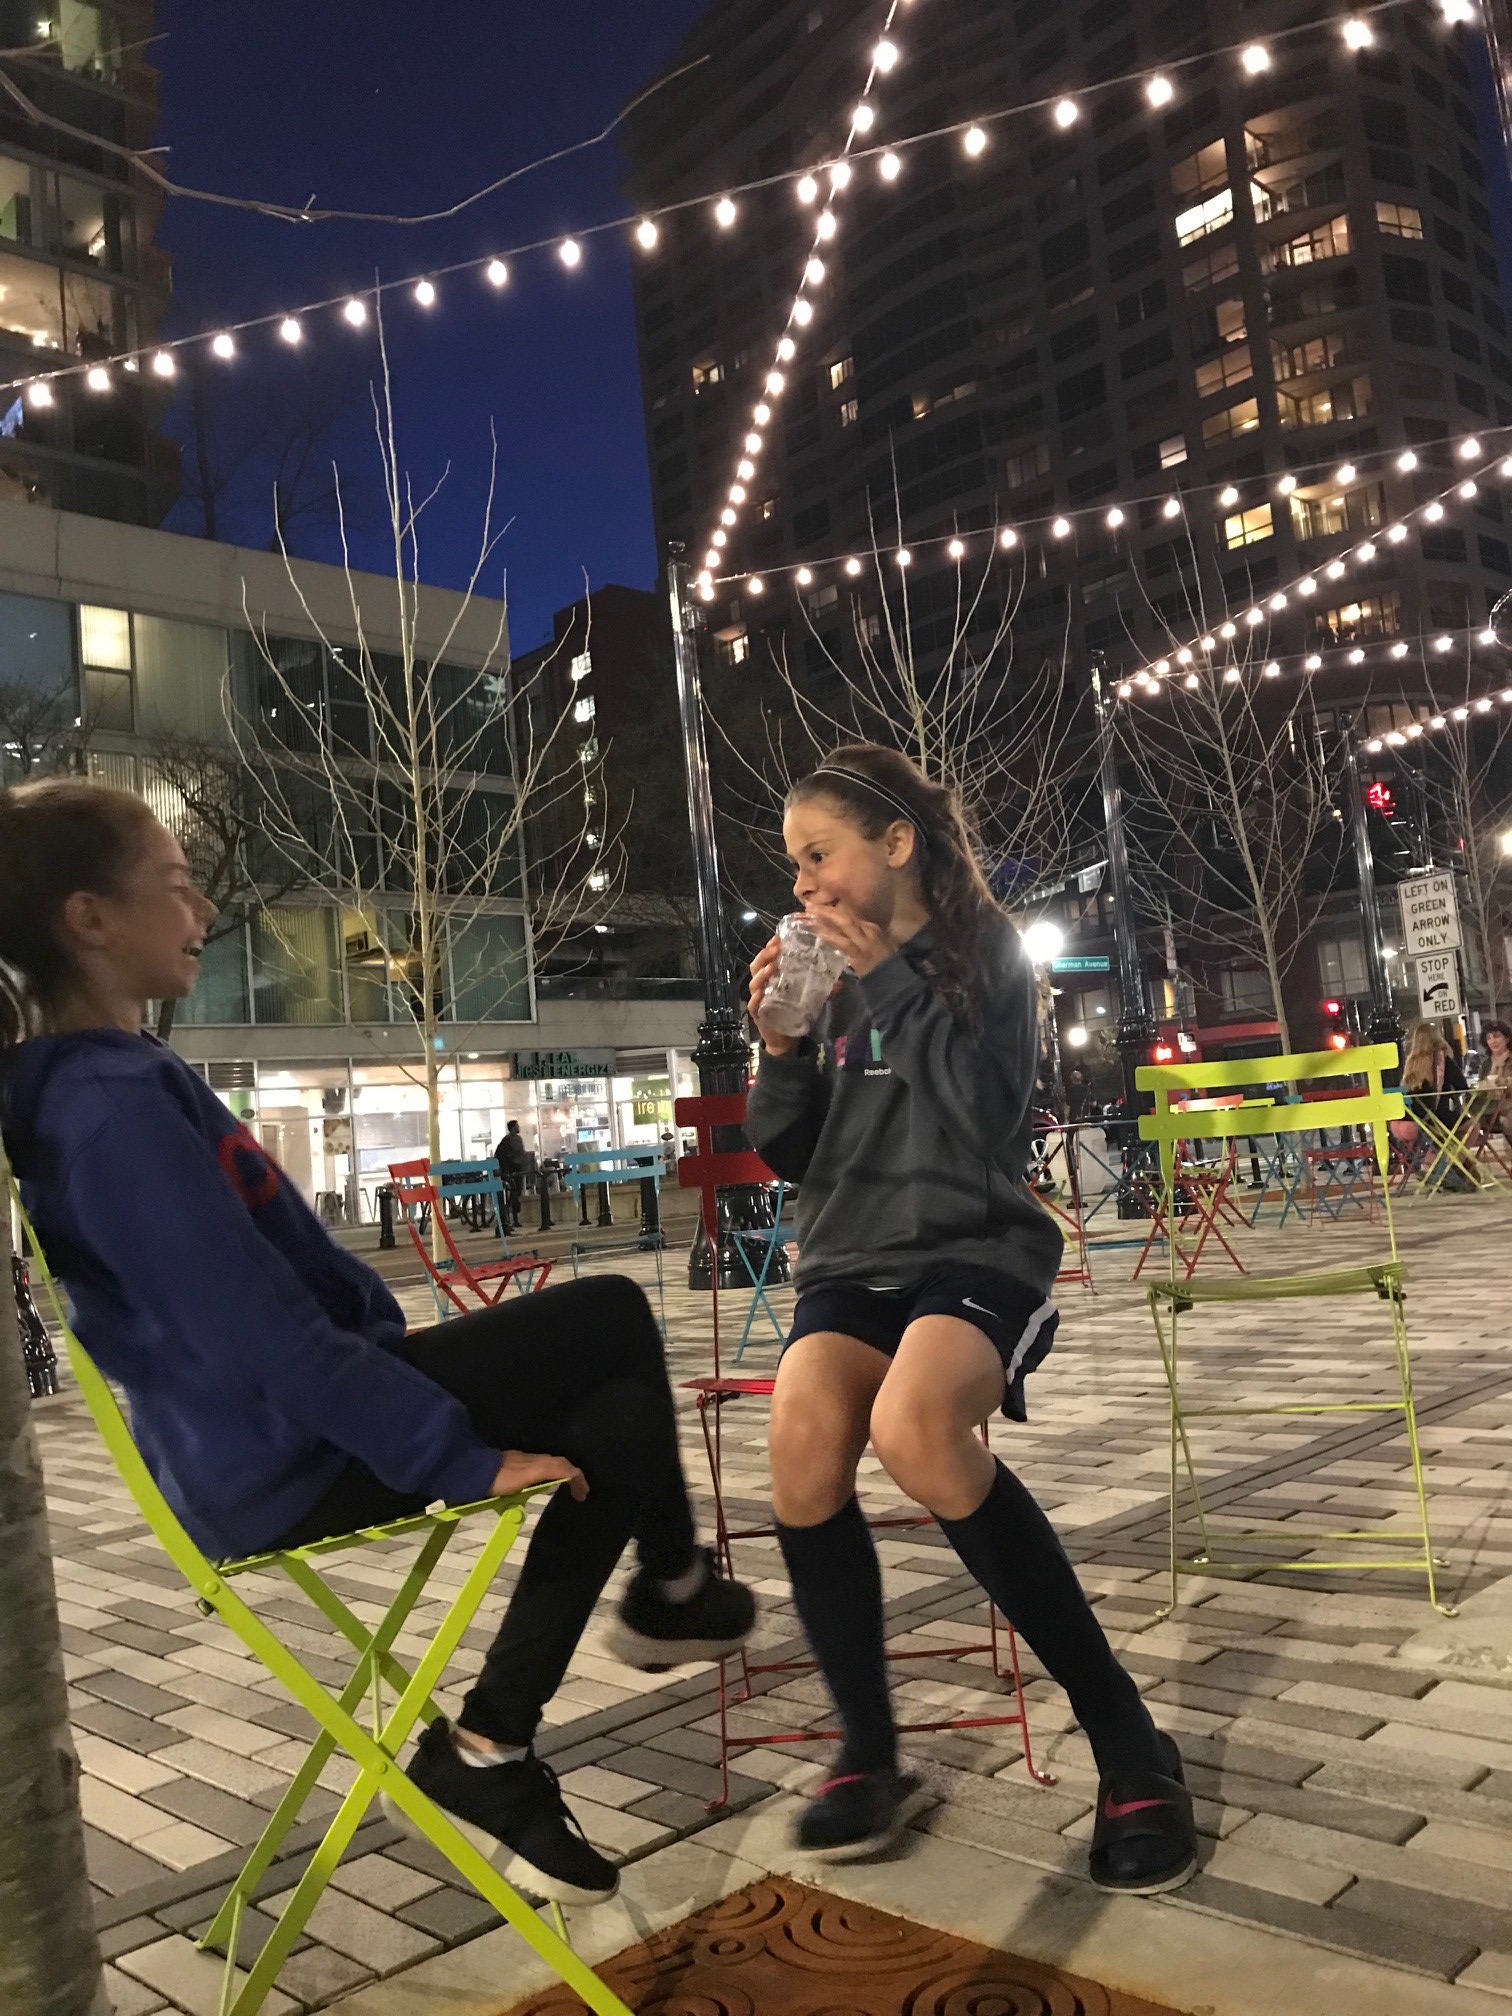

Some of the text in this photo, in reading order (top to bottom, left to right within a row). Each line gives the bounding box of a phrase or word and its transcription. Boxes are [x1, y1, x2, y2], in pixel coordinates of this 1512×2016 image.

[1405, 879, 1448, 898] LEFT ON
[1411, 898, 1446, 914] GREEN
[1412, 914, 1450, 931] ARROW
[1418, 933, 1448, 948] ONLY
[1421, 957, 1449, 973] STOP
[1428, 971, 1445, 982] HERE
[1438, 989, 1448, 998] ON
[1434, 1000, 1456, 1013] RED
